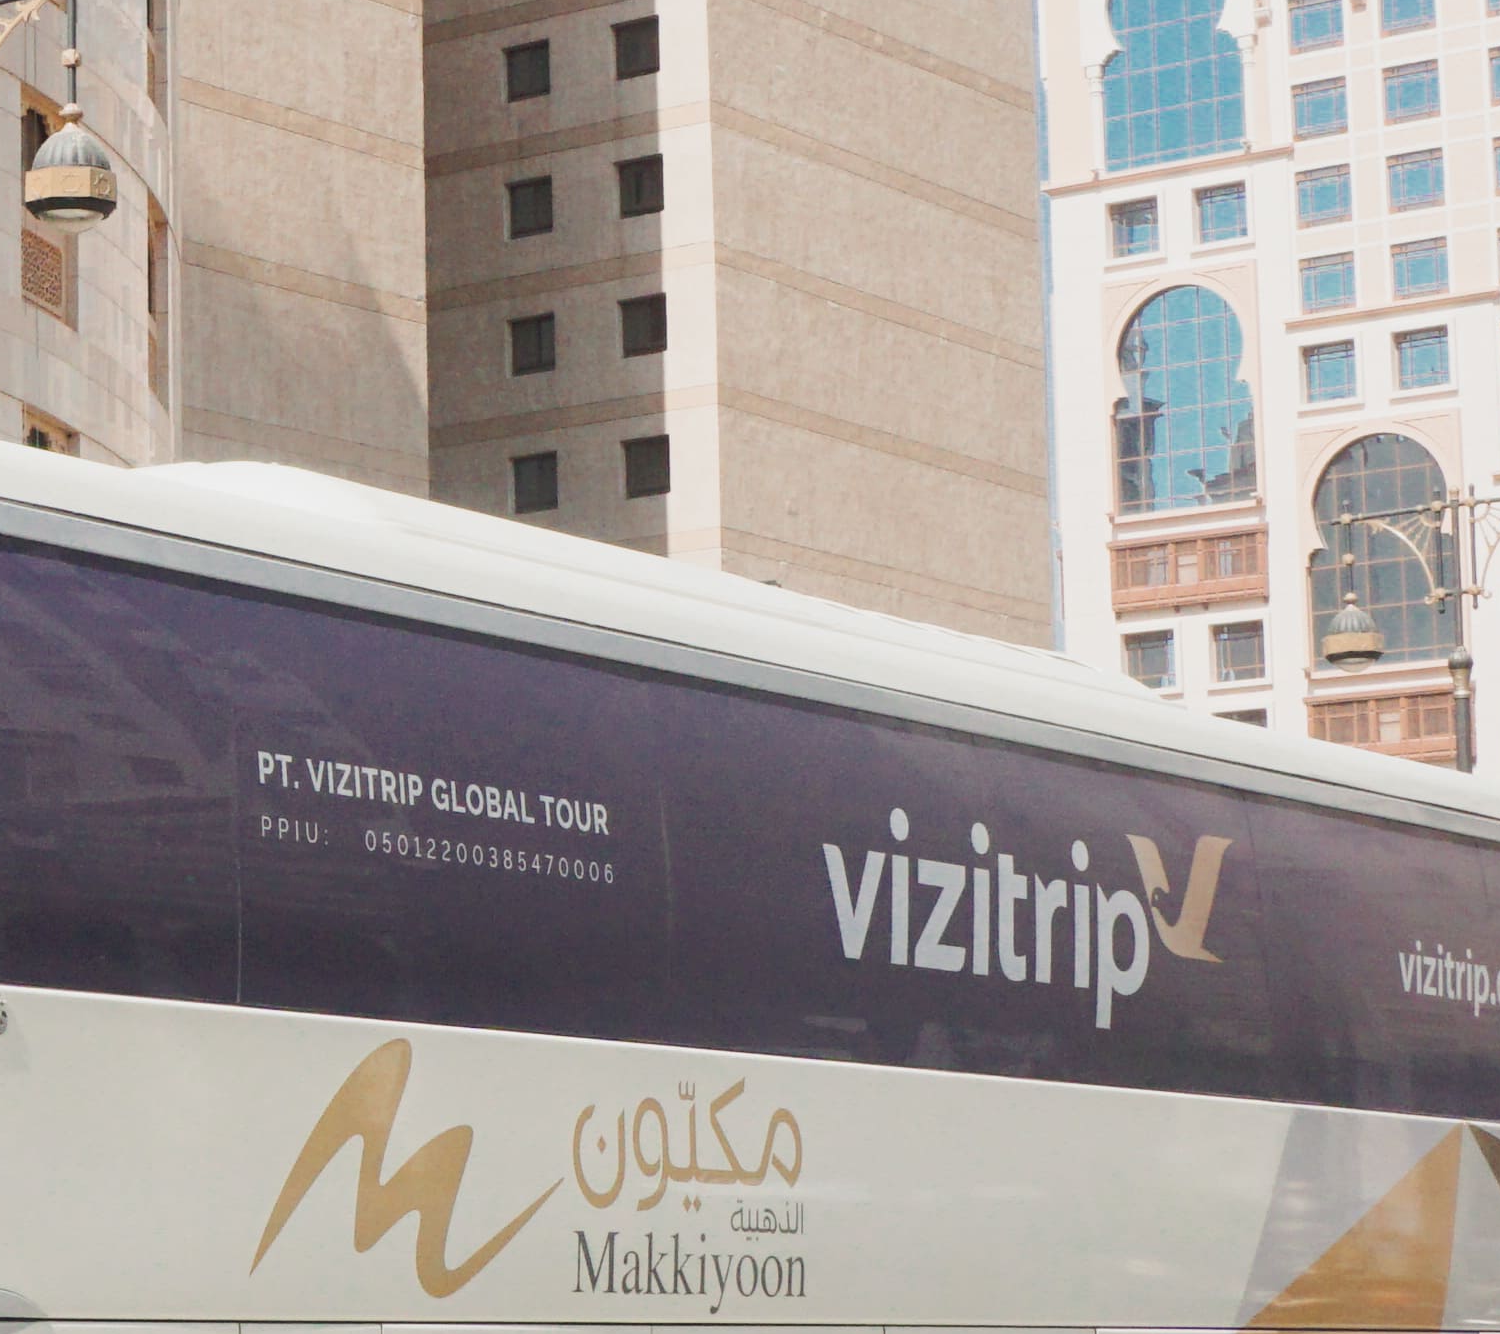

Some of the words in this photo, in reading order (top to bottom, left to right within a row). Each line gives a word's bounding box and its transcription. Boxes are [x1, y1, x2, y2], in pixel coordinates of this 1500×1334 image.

[257, 750, 300, 789] PT.
[306, 758, 423, 806] VIZITRIP
[431, 778, 536, 824] GLOBAL
[539, 794, 610, 836] TOUR
[260, 815, 330, 846] PPIU:
[364, 829, 614, 884] 05012200385470006
[821, 807, 1151, 1030] vizitrip
[729, 1198, 805, 1242] الذهبية
[571, 1229, 807, 1315] Makkiyoon
